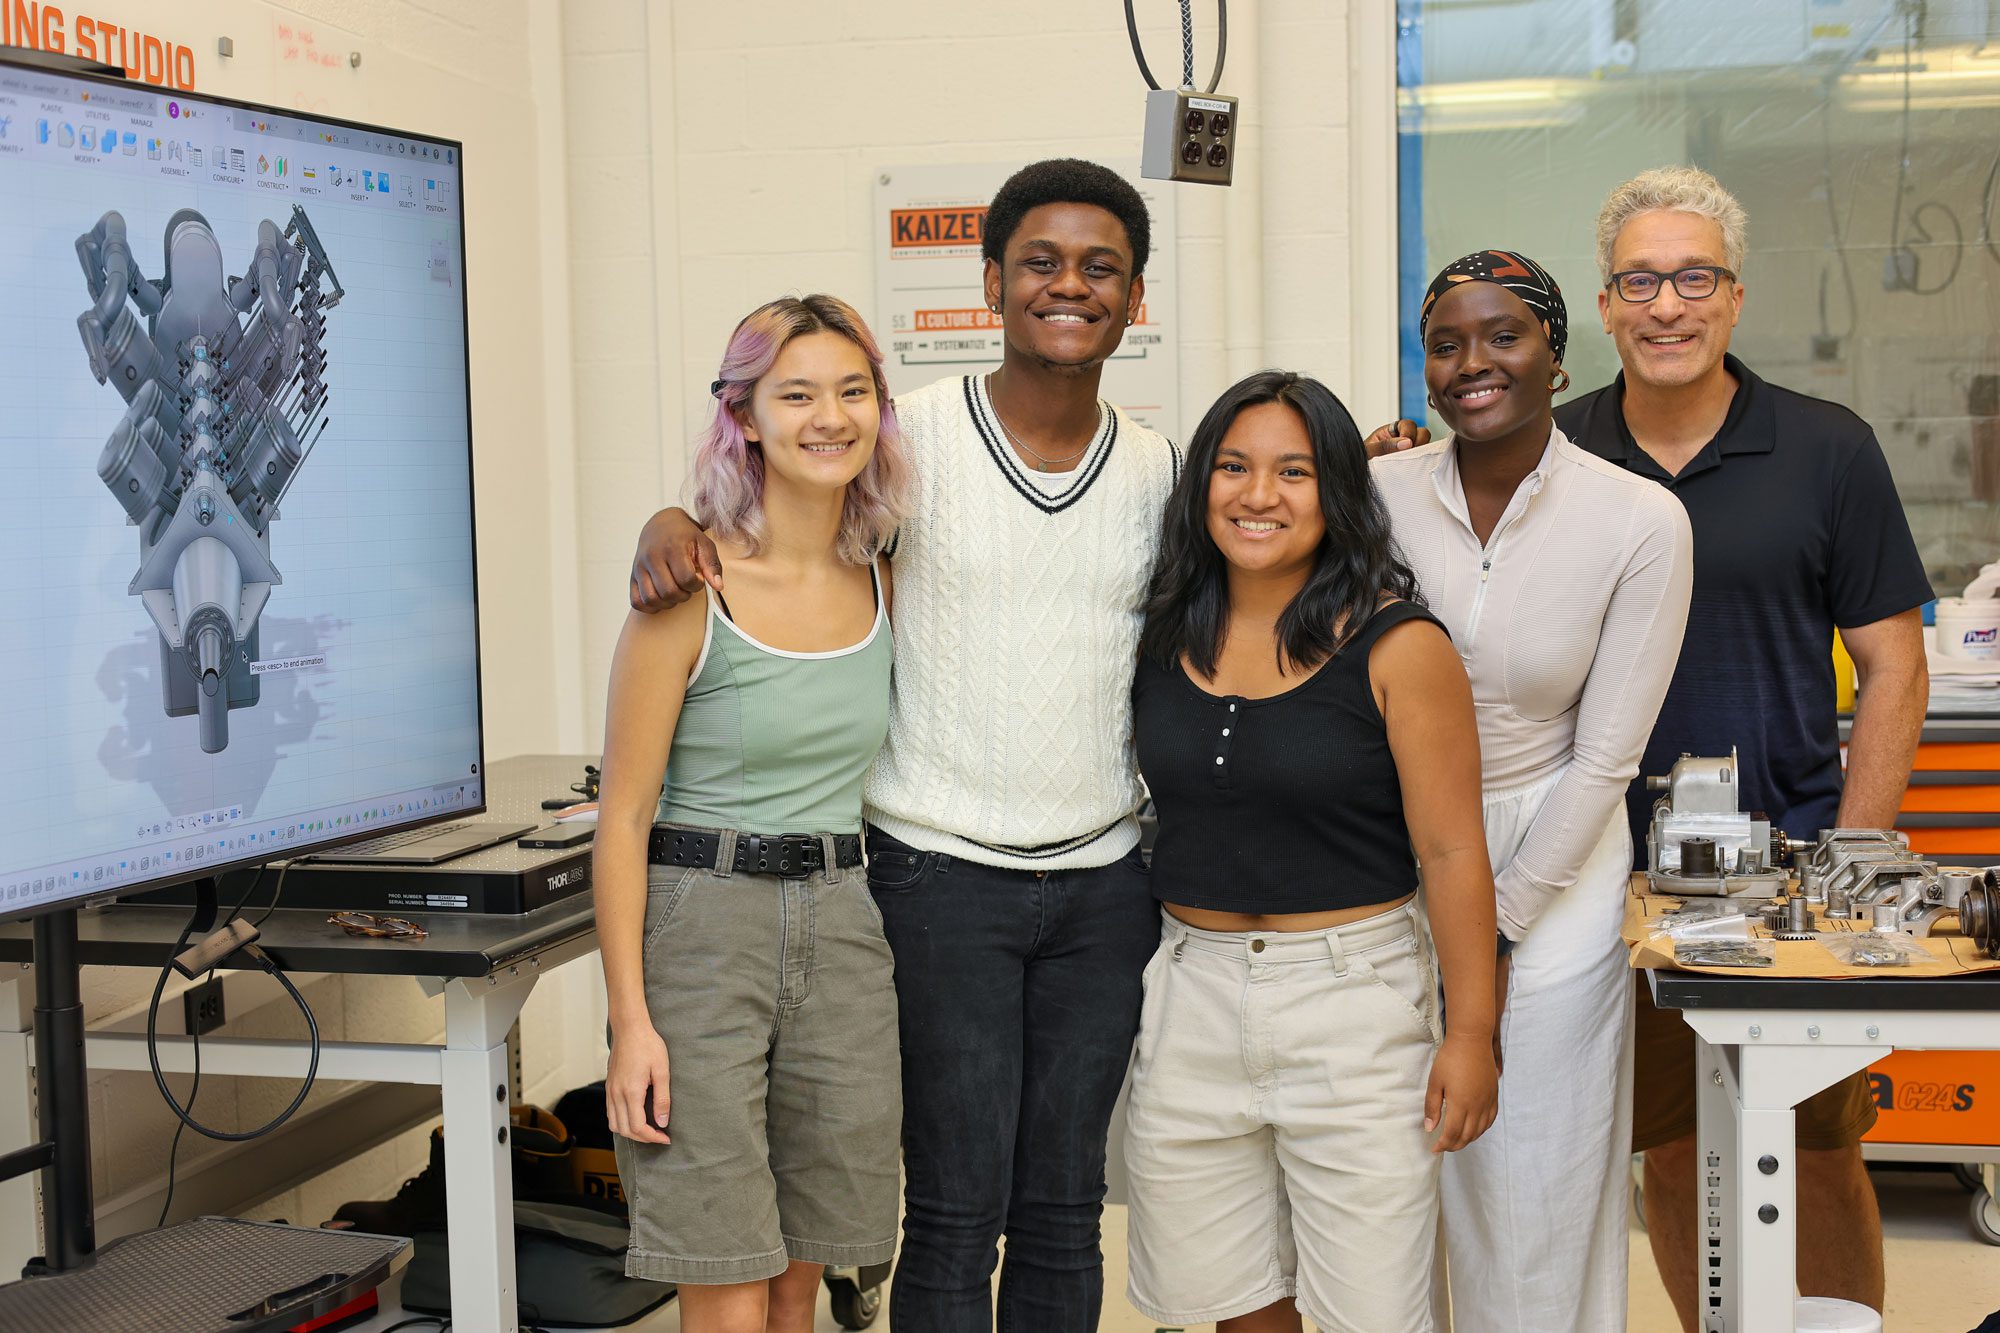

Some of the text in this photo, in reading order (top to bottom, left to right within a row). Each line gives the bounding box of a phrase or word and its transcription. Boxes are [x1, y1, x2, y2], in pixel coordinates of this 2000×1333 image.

[76, 15, 194, 92] STUDIO
[41, 102, 63, 113] PLASTIC
[130, 117, 154, 128] MANAGE
[74, 154, 96, 164] MODIFY
[160, 166, 185, 177] ASSEMBLE
[212, 173, 241, 185] CONFIGURE
[257, 180, 285, 190] CONSTRUCT
[300, 186, 318, 195] INSPECT
[399, 201, 413, 209] SELECT
[425, 204, 445, 213] POSITION
[917, 314, 925, 328] A
[926, 312, 975, 328] CULTURE
[975, 311, 991, 327] OF
[1127, 334, 1162, 345] SUSTAIN
[893, 339, 986, 352] SORT SYSTEMATIZE
[251, 664, 266, 672] Press
[267, 662, 282, 670] <esc>
[290, 659, 299, 667] end
[300, 657, 323, 665] animation
[547, 866, 584, 891] THORLABS
